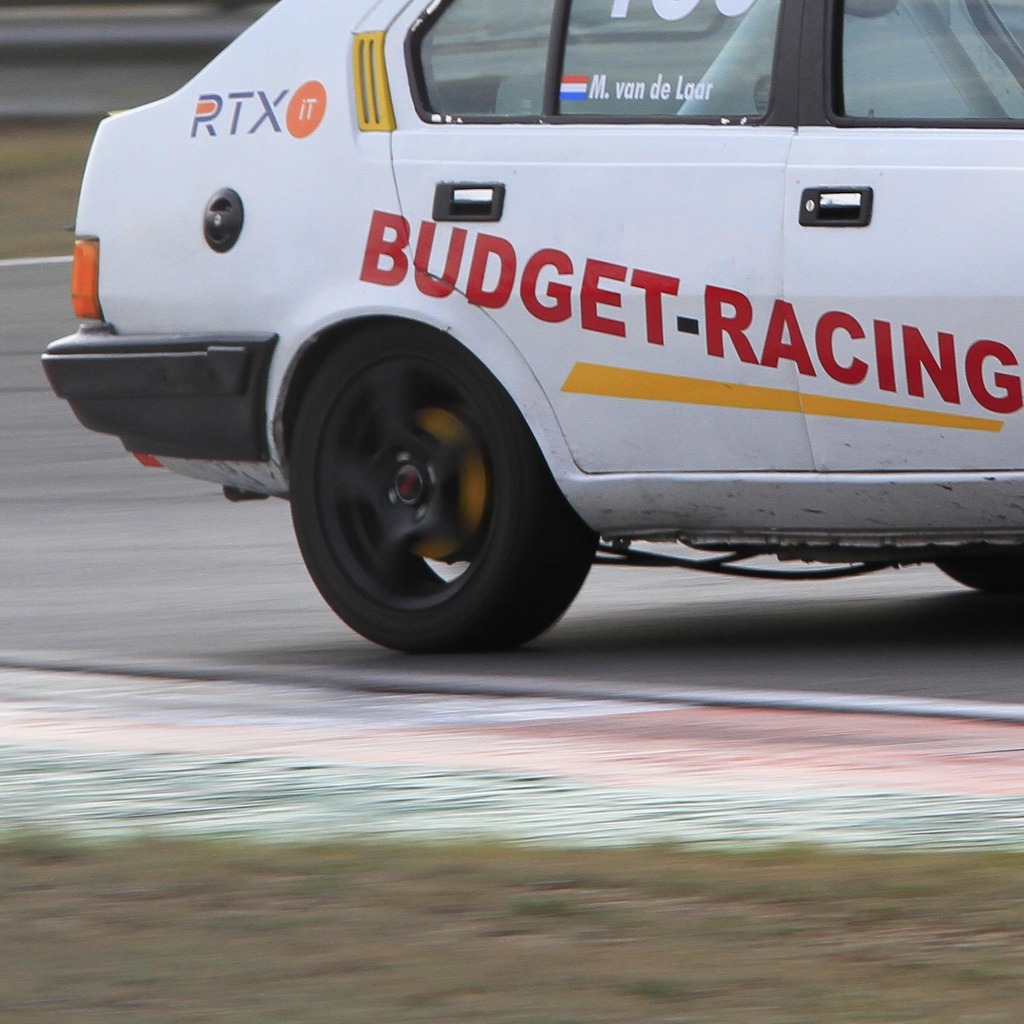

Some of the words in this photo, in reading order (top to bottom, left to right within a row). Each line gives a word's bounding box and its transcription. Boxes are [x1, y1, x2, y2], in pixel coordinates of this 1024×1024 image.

[589, 74, 610, 99] M.
[615, 81, 645, 100] van
[650, 73, 671, 100] de
[675, 75, 714, 101] Laar
[190, 89, 290, 138] RTX
